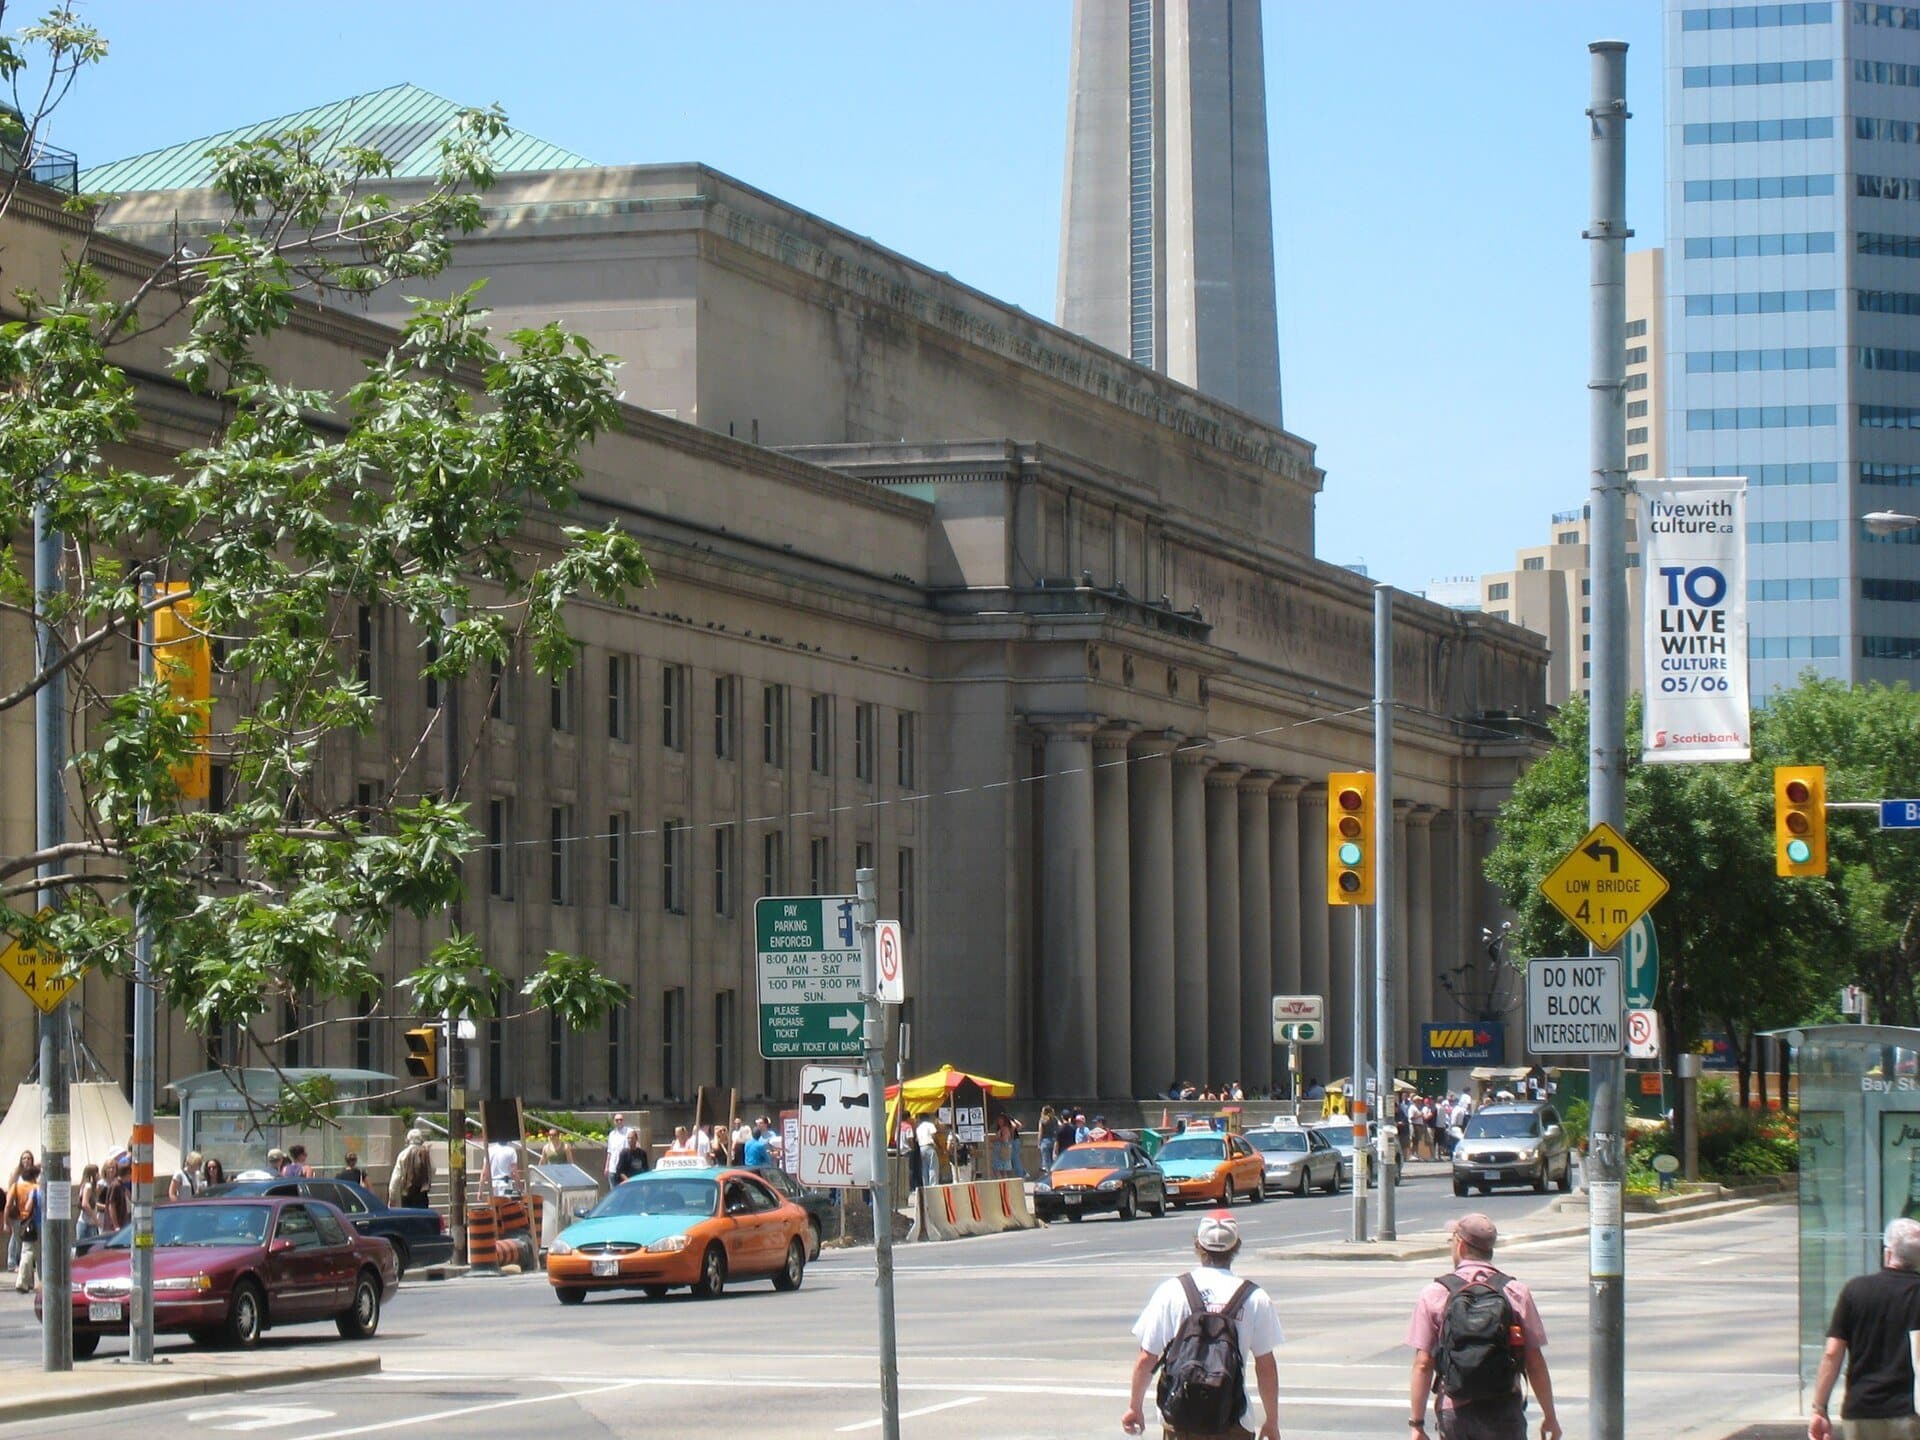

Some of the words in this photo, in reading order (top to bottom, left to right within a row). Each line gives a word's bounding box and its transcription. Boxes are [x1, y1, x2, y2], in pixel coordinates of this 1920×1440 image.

[1650, 500, 1732, 516] livewith
[1651, 517, 1733, 533] culture.ca
[1659, 566, 1727, 607] TO
[1660, 609, 1726, 633] LIVE
[1661, 636, 1726, 655] WITH
[1661, 658, 1727, 671] CULTURE
[1672, 733, 1740, 744] Scotiabank
[1906, 803, 1920, 820] B
[1566, 880, 1590, 893] LOW
[1597, 880, 1640, 893] BRIDGE
[784, 905, 798, 917] PAY
[774, 920, 808, 932] PARKING
[770, 936, 812, 948] ENFORCED
[17, 954, 37, 966] LOW
[766, 955, 788, 964] 8:00
[792, 954, 807, 964] AM
[820, 953, 843, 963] 9:00
[847, 953, 861, 963] PM
[786, 966, 809, 976] MON
[823, 965, 840, 975] SAT
[1544, 967, 1566, 988] DO
[1572, 966, 1604, 988] NOT
[768, 980, 788, 990] 1:00
[792, 979, 807, 989] PM
[820, 979, 842, 989] 9:00
[846, 979, 861, 988] PM
[803, 992, 827, 1001] SUN.
[774, 1007, 800, 1016] PLEASE
[1547, 995, 1601, 1017] BLOCK
[768, 1017, 805, 1027] PURCHASE
[775, 1029, 799, 1038] TICKET
[1430, 1030, 1474, 1048] VIA
[1533, 1023, 1617, 1045] INTERSECTION
[772, 1043, 799, 1053] DISPLAY
[802, 1043, 825, 1051] TICKET
[828, 1042, 839, 1051] ON
[841, 1042, 860, 1051] DASH
[1862, 1077, 1893, 1094] Bay
[818, 1152, 853, 1175] ZONE
